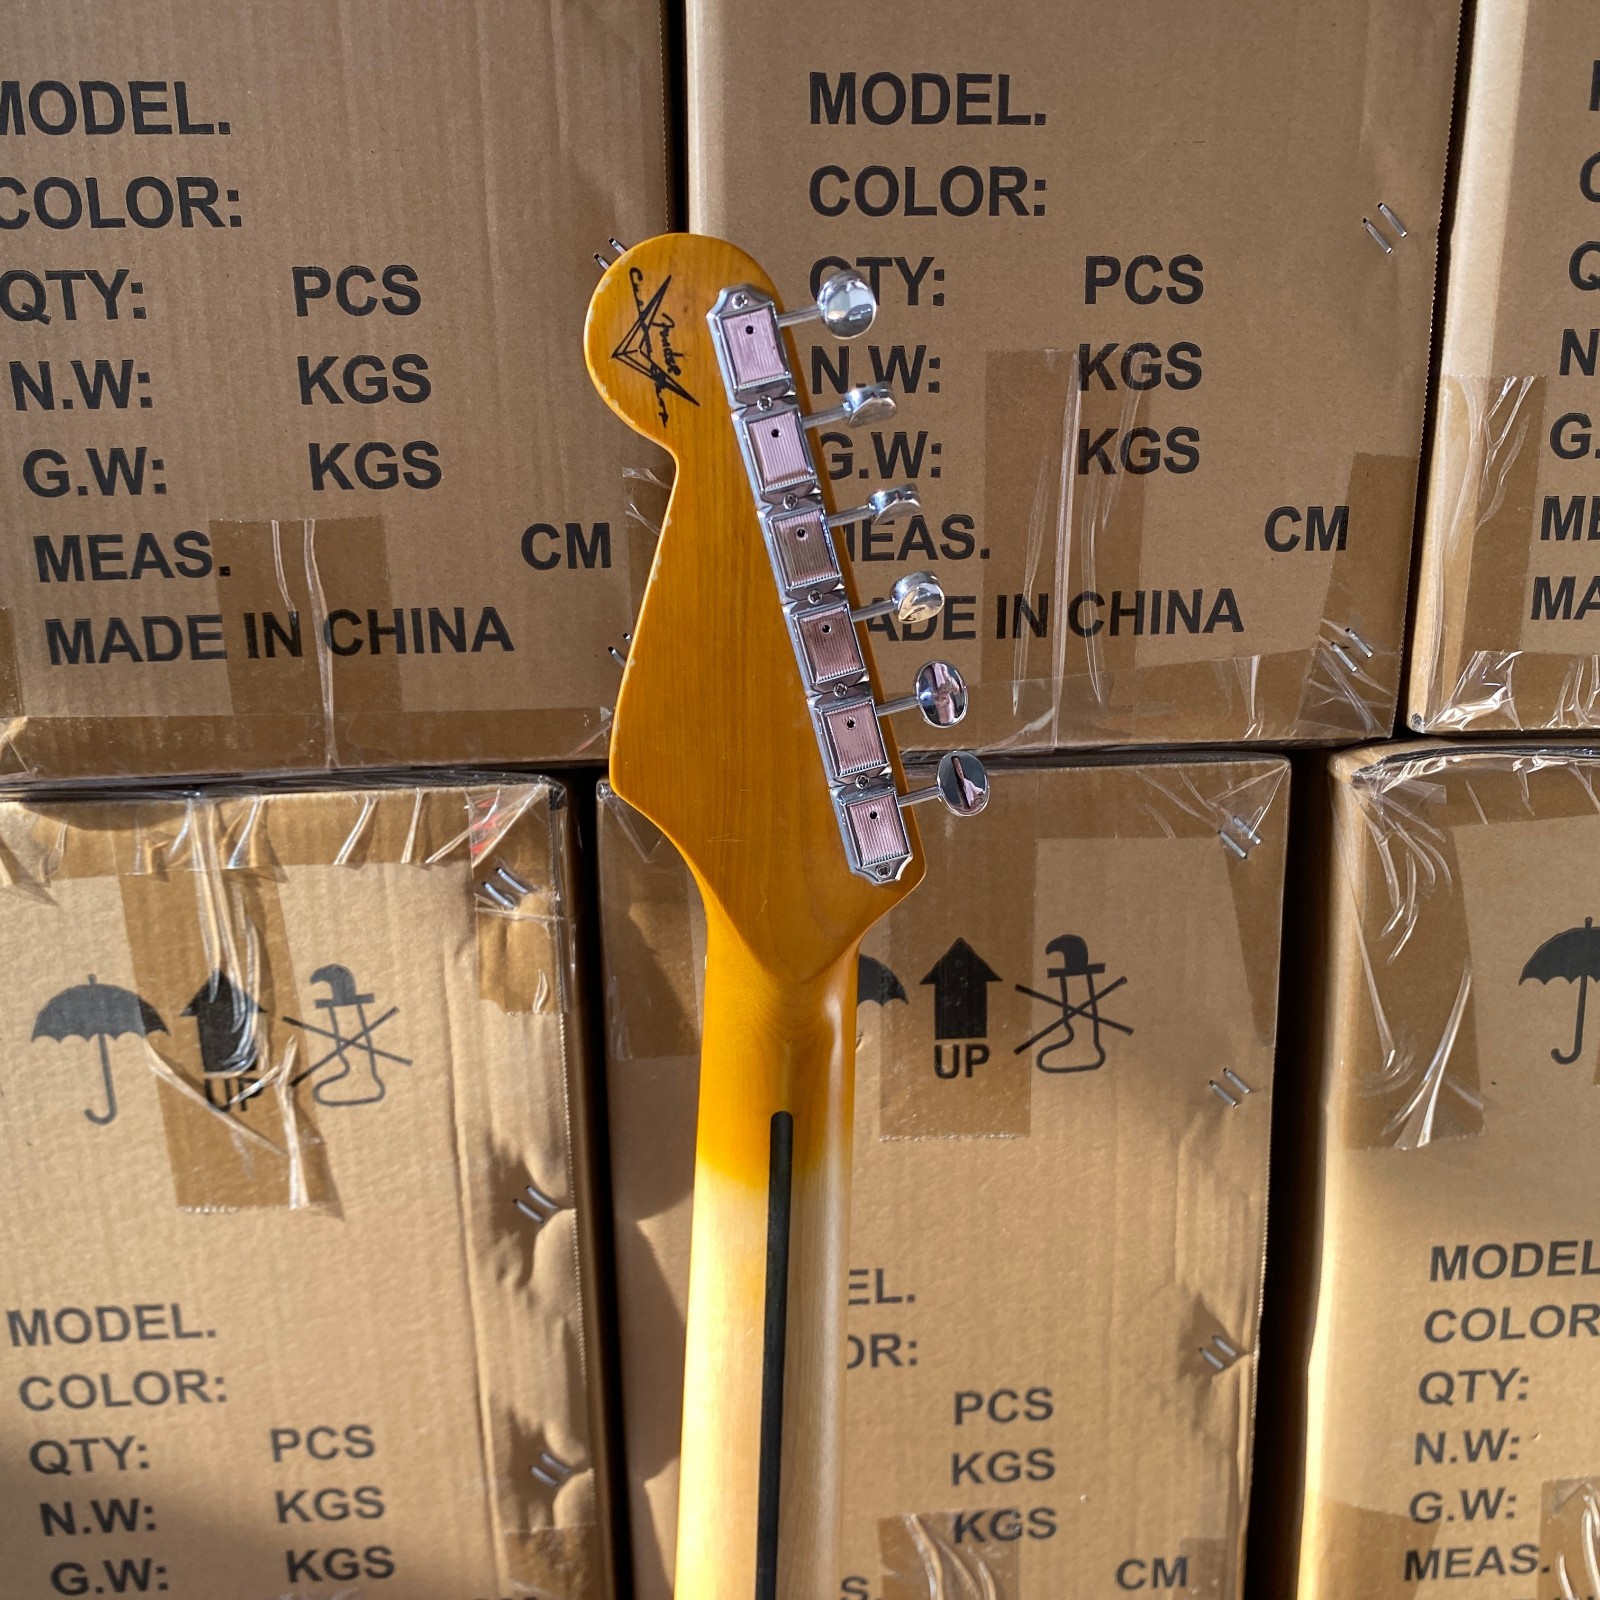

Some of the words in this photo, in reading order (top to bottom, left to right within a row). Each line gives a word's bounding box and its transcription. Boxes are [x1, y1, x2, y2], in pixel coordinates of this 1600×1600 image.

[810, 72, 1046, 125] MODEL.
[0, 177, 242, 229] COLOR:
[810, 165, 1046, 217] COLOR:
[0, 269, 146, 325] QTY:
[292, 265, 421, 317] PCS
[1085, 254, 1203, 305] PCS
[9, 360, 152, 411] N.W:
[297, 354, 431, 405] KGS
[812, 345, 940, 395] N.W:
[1078, 342, 1202, 391] KGS
[23, 447, 166, 497] G.W:
[309, 441, 441, 490] KGS
[820, 431, 941, 481] G.W:
[1078, 427, 1199, 475] KGS
[33, 531, 231, 583] MEAS.
[521, 523, 611, 570] CM
[846, 514, 990, 561] EAS.
[1265, 506, 1349, 552] CM
[45, 614, 227, 665] MADE
[244, 612, 302, 658] IN
[324, 607, 514, 656] CHINA
[996, 593, 1048, 639] IN
[1068, 589, 1244, 638] CHINA
[934, 1044, 990, 1079] UP
[7, 1303, 216, 1347] MODEL.
[18, 1369, 227, 1411] COLOR:
[955, 1388, 1053, 1425] PCS
[1420, 1369, 1528, 1405] QTY:
[29, 1437, 148, 1475] QTY:
[272, 1426, 373, 1461] PCS
[952, 1448, 1055, 1486] KGS
[1416, 1429, 1519, 1464] N.W:
[40, 1499, 155, 1536] N.W:
[276, 1487, 384, 1523] KGS
[952, 1508, 1056, 1545] KGS
[1410, 1488, 1514, 1525] G.W:
[51, 1558, 168, 1596] G.W:
[286, 1547, 394, 1583] KGS
[1116, 1556, 1189, 1590] CM
[1403, 1545, 1550, 1581] MEAS.
